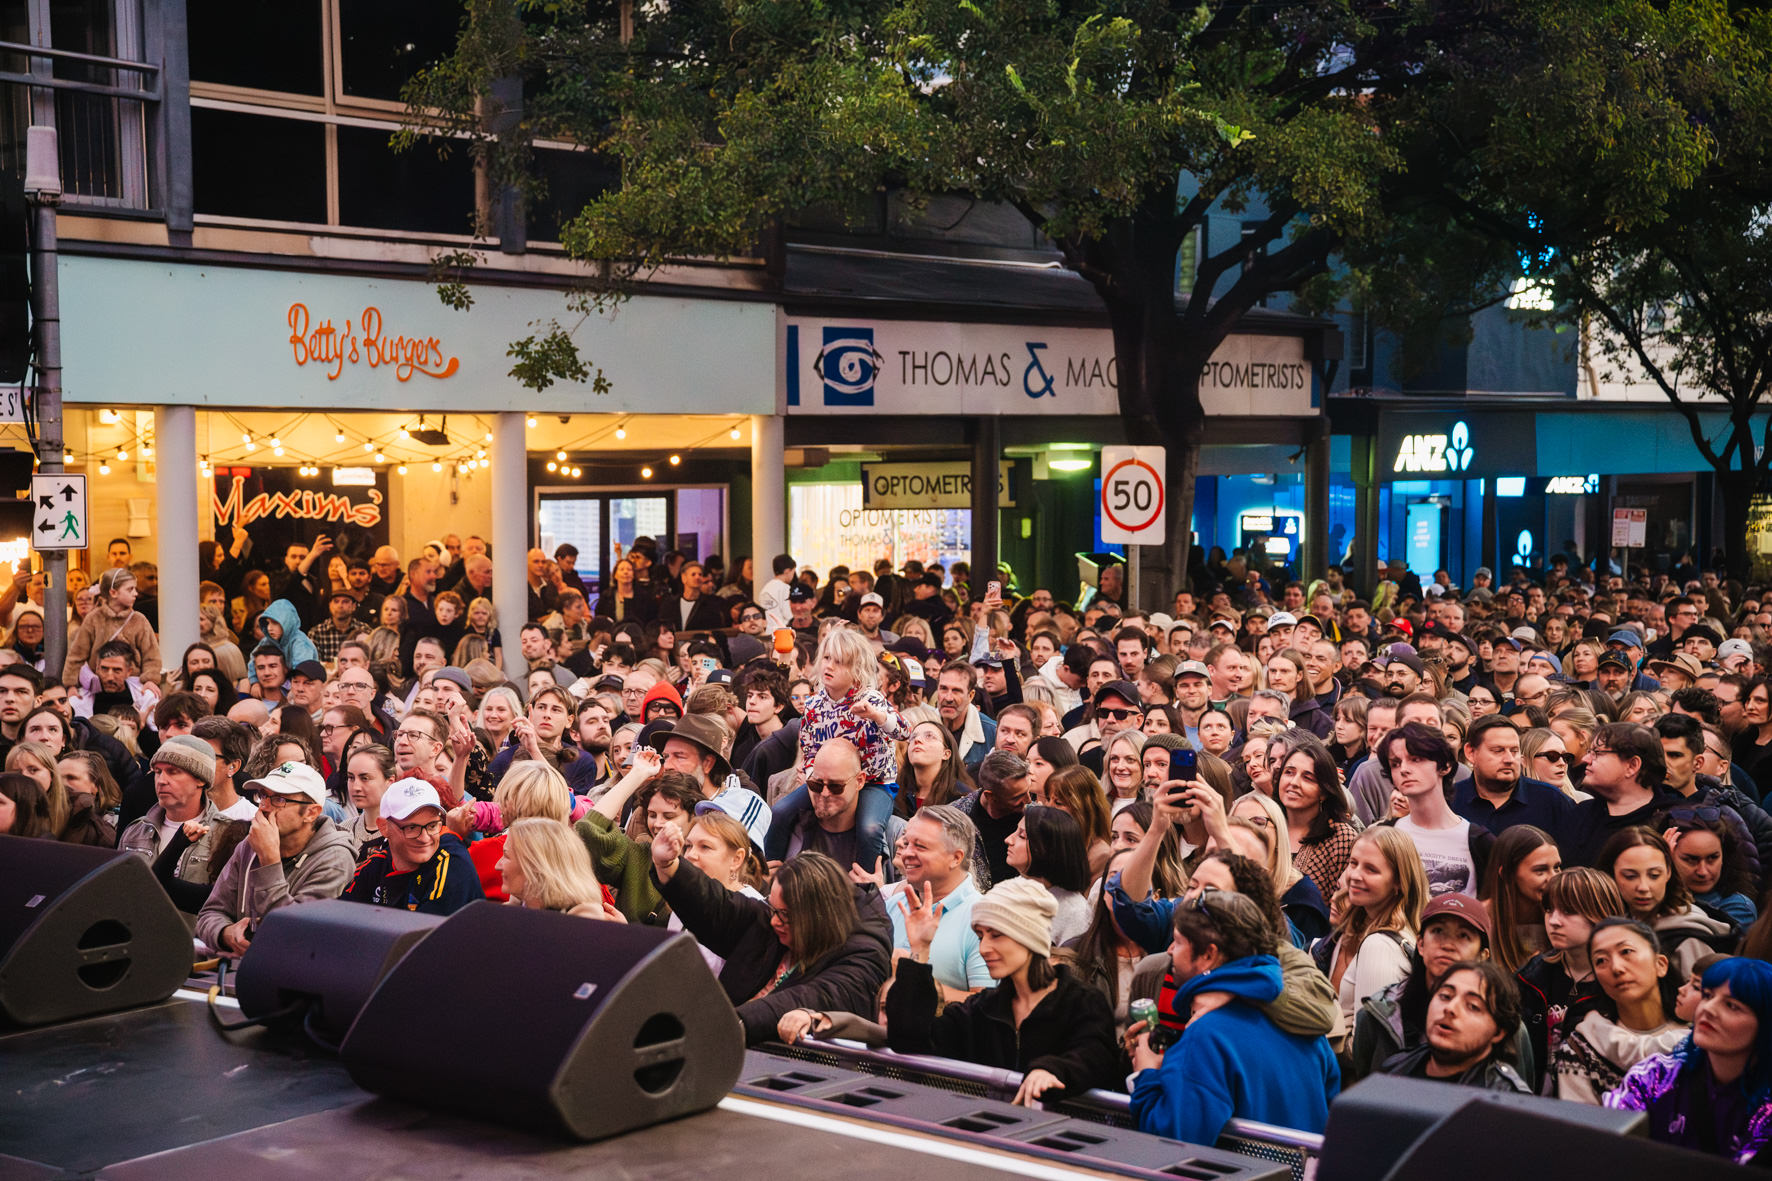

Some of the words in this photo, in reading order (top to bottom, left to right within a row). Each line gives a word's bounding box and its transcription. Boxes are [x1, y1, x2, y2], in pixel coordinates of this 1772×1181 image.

[288, 303, 360, 381] Betty's
[361, 306, 460, 382] Burgers
[898, 350, 1011, 387] THOMAS
[1023, 342, 1056, 399] &
[1200, 361, 1304, 389] PTOMETRISTS
[1393, 434, 1447, 472] ANZ
[1113, 480, 1152, 511] 50
[1545, 476, 1585, 494] ANZ
